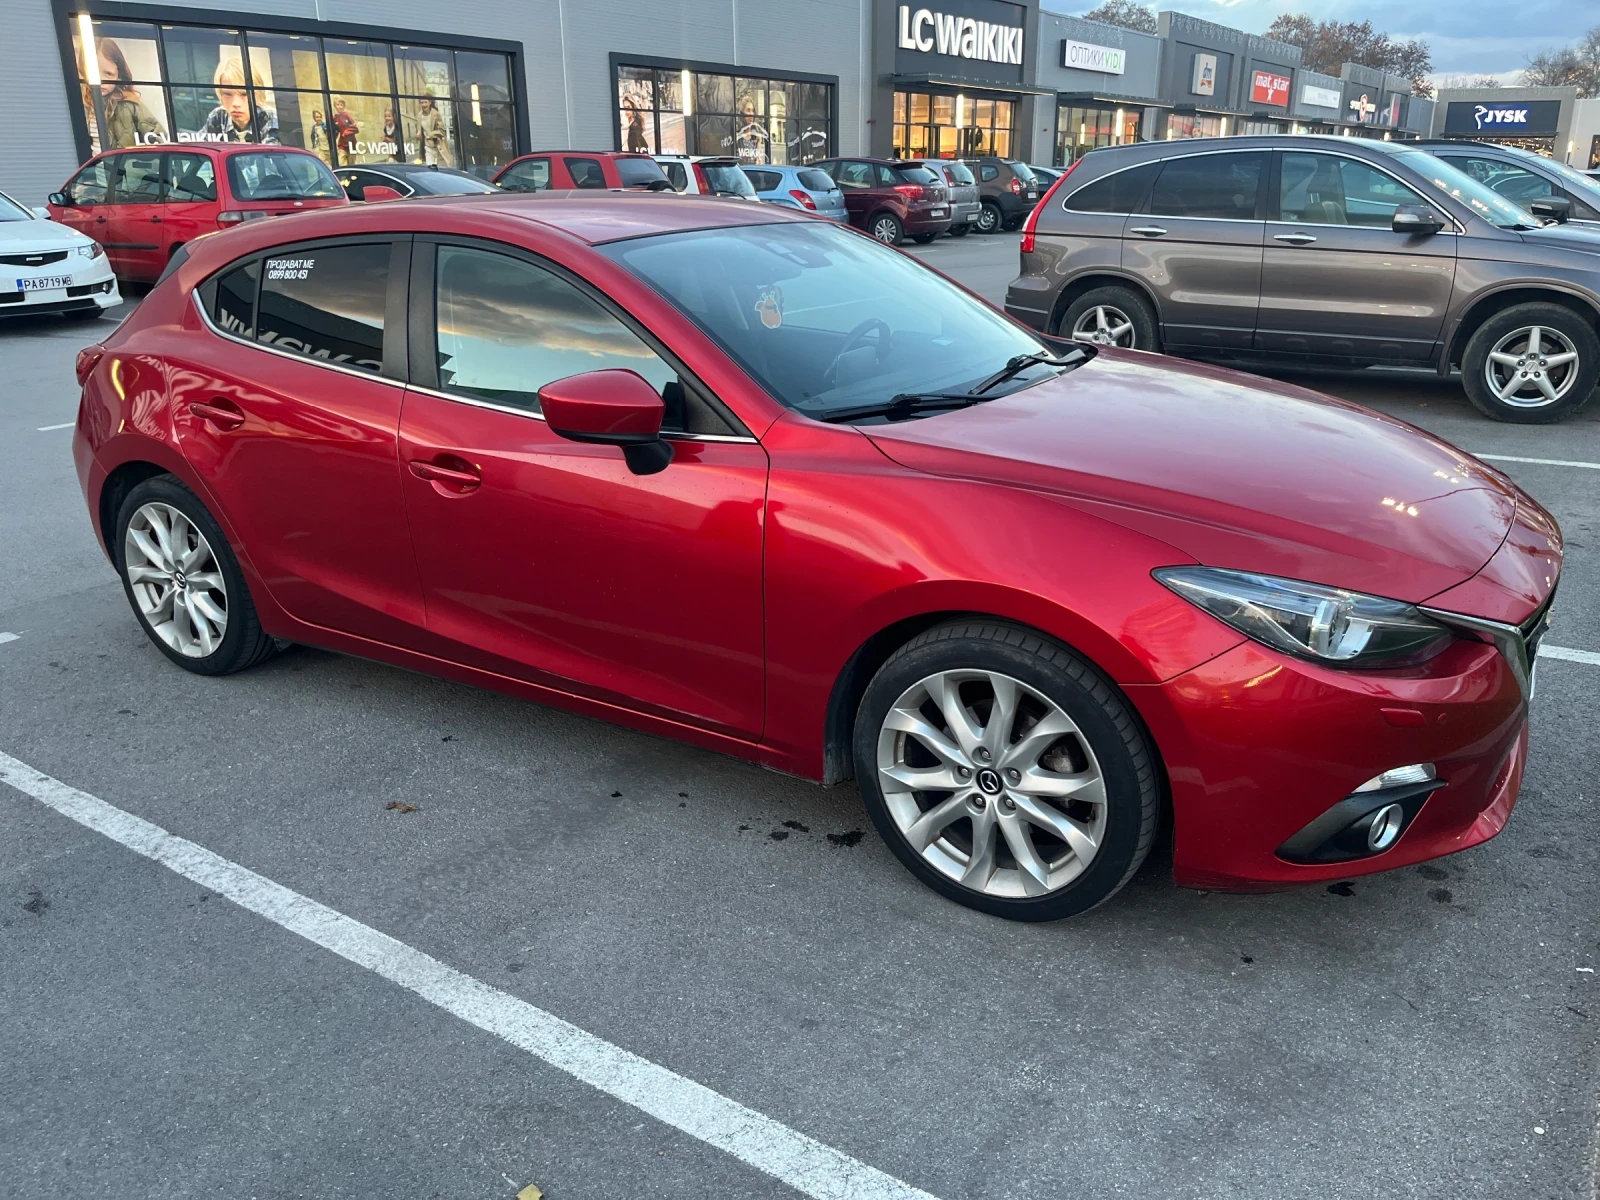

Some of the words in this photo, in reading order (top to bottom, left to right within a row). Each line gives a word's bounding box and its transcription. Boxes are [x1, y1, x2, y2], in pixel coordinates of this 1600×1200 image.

[899, 5, 934, 52] LC
[1071, 45, 1104, 67] ОПТИКИ
[1105, 51, 1121, 69] VIDI
[1255, 75, 1272, 89] mat
[1272, 77, 1289, 91] star
[1484, 109, 1528, 123] JYSK
[133, 131, 160, 146] LC
[348, 141, 366, 155] LC
[268, 270, 284, 280] 0899
[284, 270, 297, 280] 800
